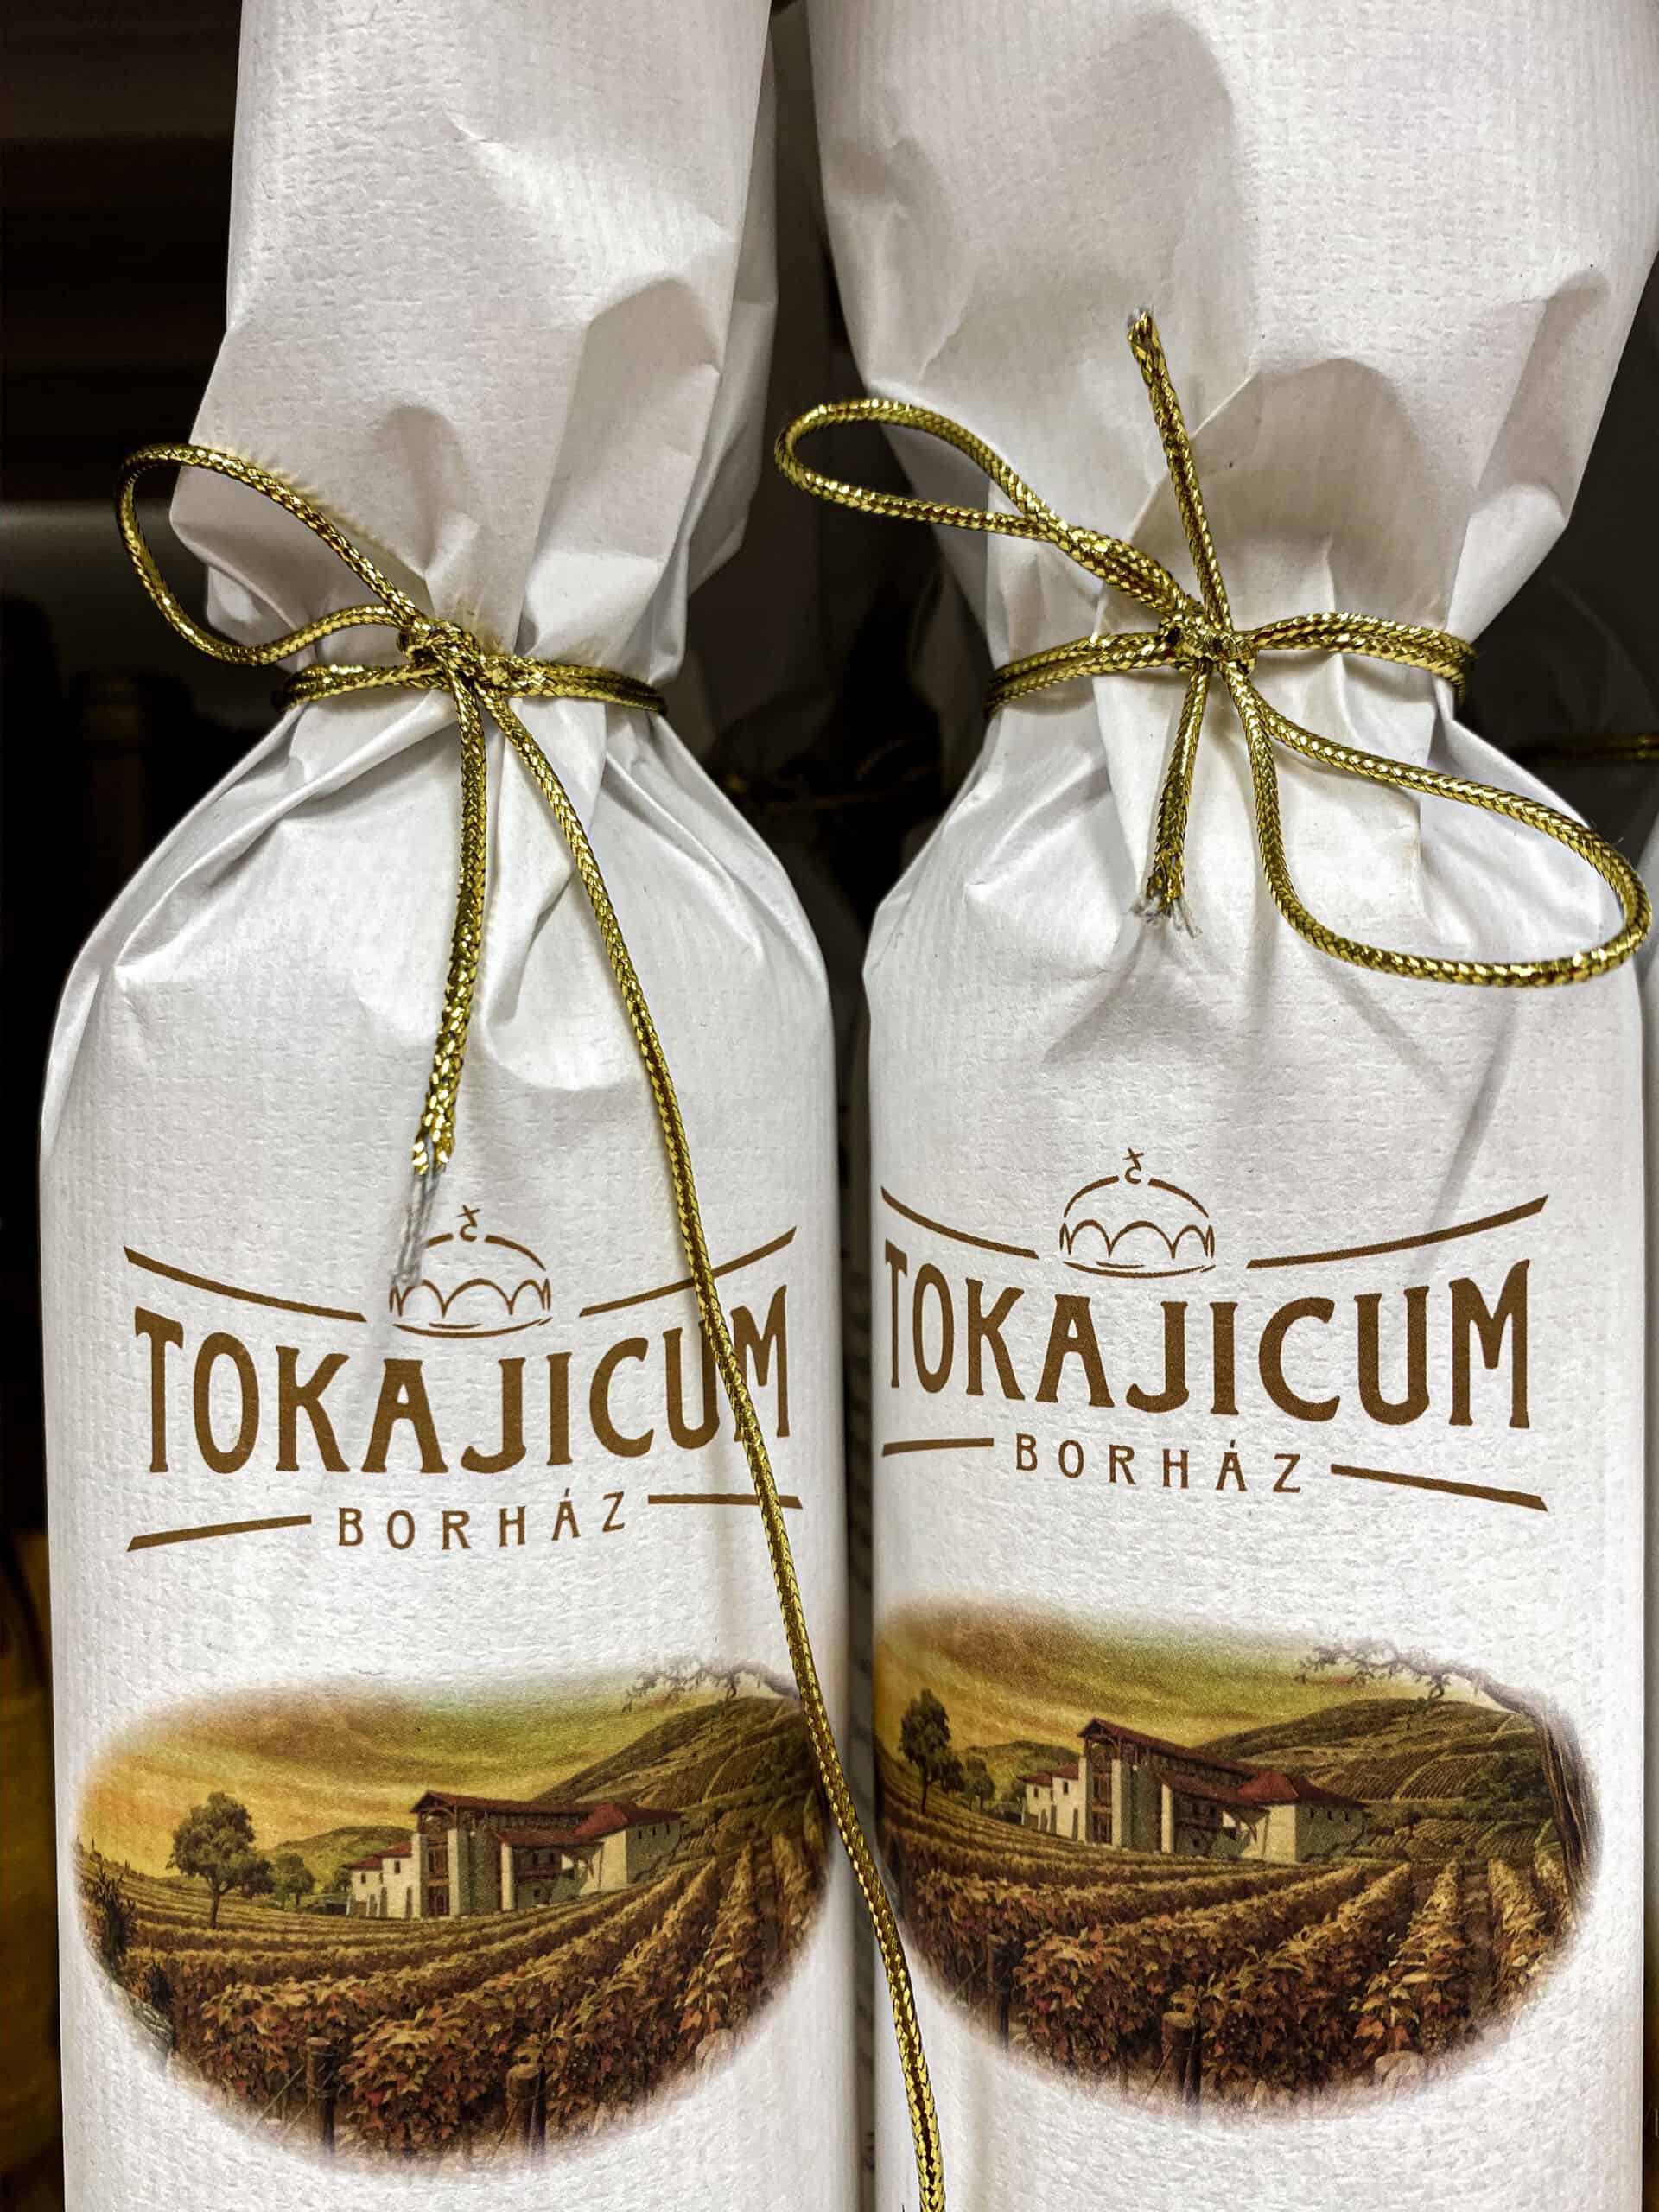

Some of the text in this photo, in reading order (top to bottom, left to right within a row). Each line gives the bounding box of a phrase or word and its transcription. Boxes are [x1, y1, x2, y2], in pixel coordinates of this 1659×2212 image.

[135, 1284, 790, 1473] TOKAJICUM
[885, 1239, 1530, 1428] TOKAJICUM
[338, 1488, 626, 1551] BORHÁZ
[1015, 1433, 1301, 1493] BORHÁZ
